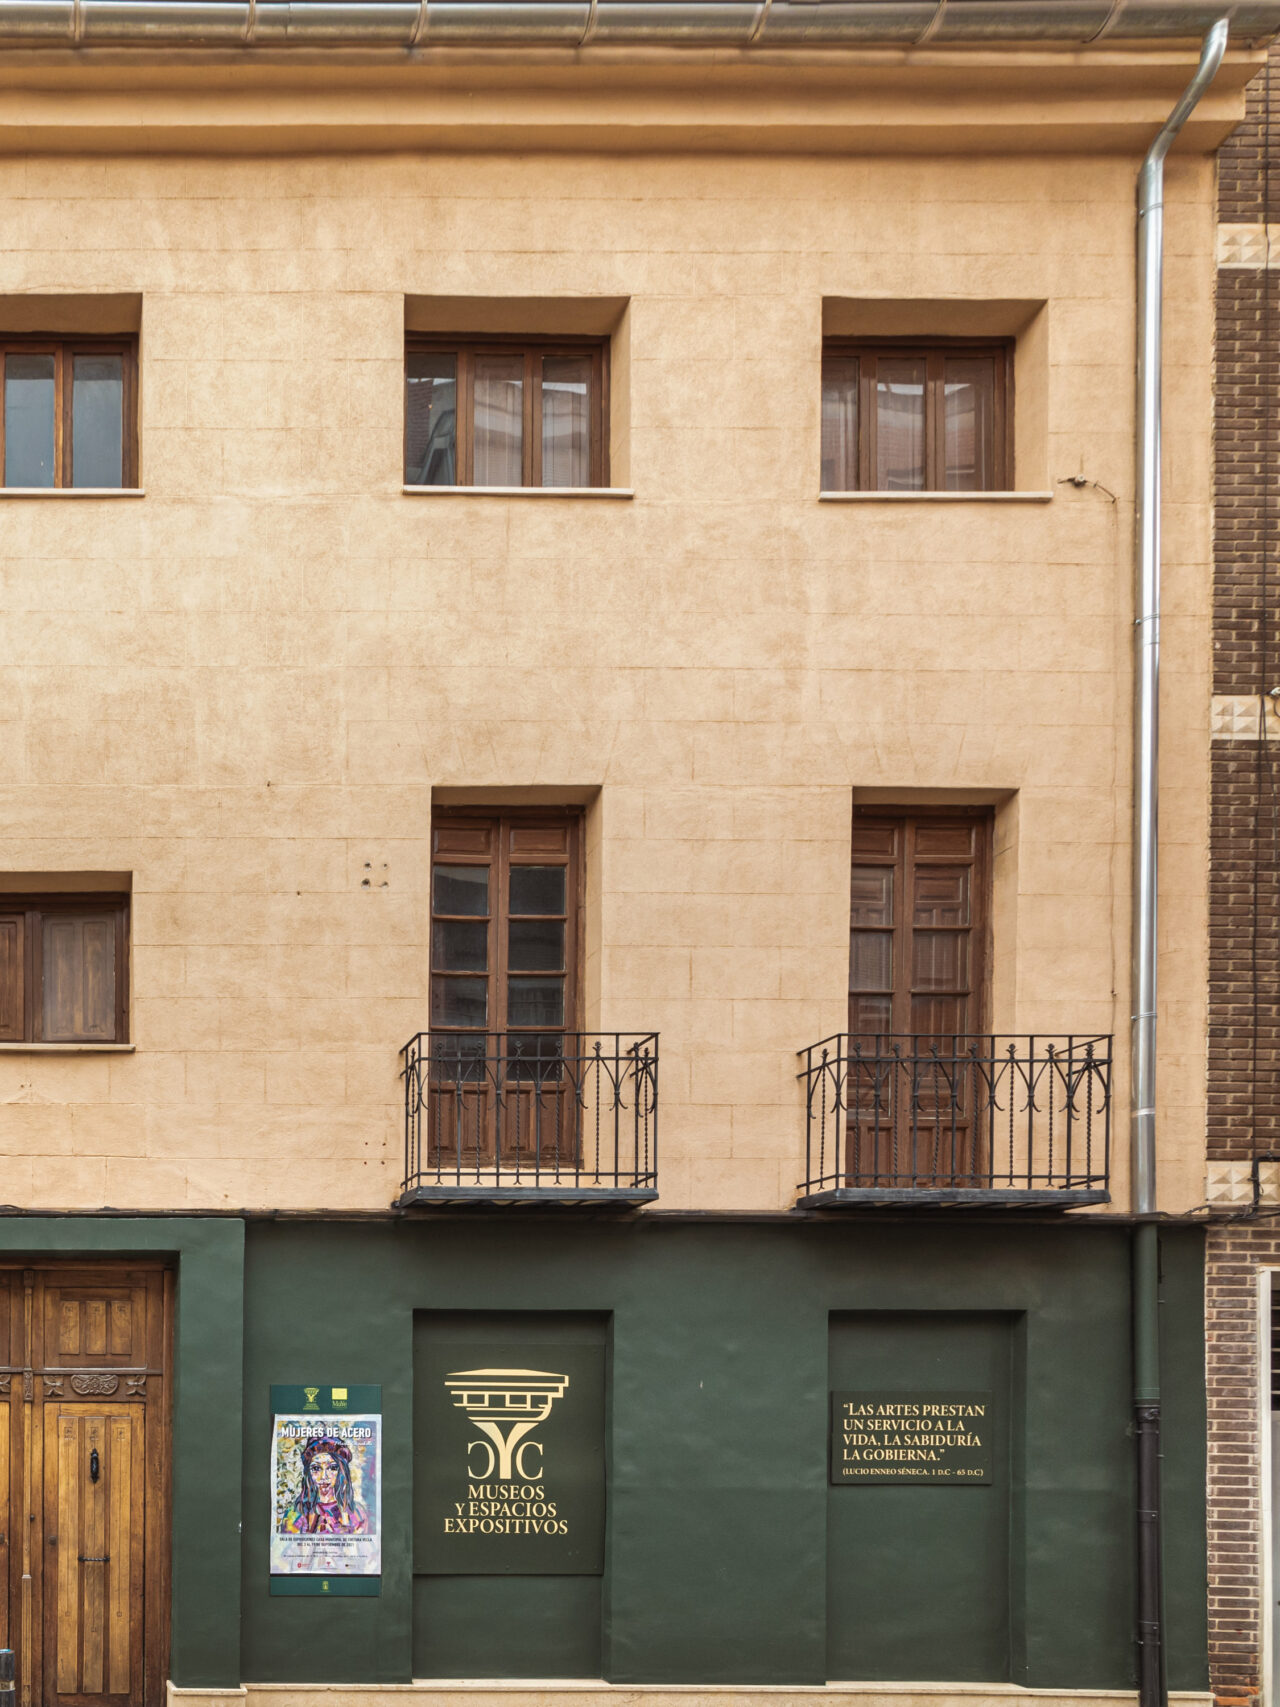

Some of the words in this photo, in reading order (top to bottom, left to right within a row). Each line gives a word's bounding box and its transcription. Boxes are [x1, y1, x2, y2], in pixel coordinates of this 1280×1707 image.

[875, 1403, 920, 1416] ARTES
[922, 1404, 986, 1417] PRESTAN
[281, 1427, 324, 1437] MUJERES
[326, 1427, 339, 1438] DE
[341, 1427, 372, 1438] ACERO
[843, 1419, 864, 1431] UN
[866, 1419, 933, 1431] SERVICIO
[934, 1420, 945, 1431] A
[947, 1420, 966, 1432] LA
[843, 1434, 882, 1447] VIDA,
[884, 1434, 902, 1446] LA
[903, 1432, 982, 1447] SABIDURÍA
[843, 1449, 861, 1461] LA
[870, 1467, 897, 1476] ENNEO
[468, 1484, 545, 1501] MUSEOS
[455, 1502, 466, 1516] Y
[469, 1501, 557, 1518] ESPACIOS
[443, 1518, 569, 1535] EXPOSITIVOS
